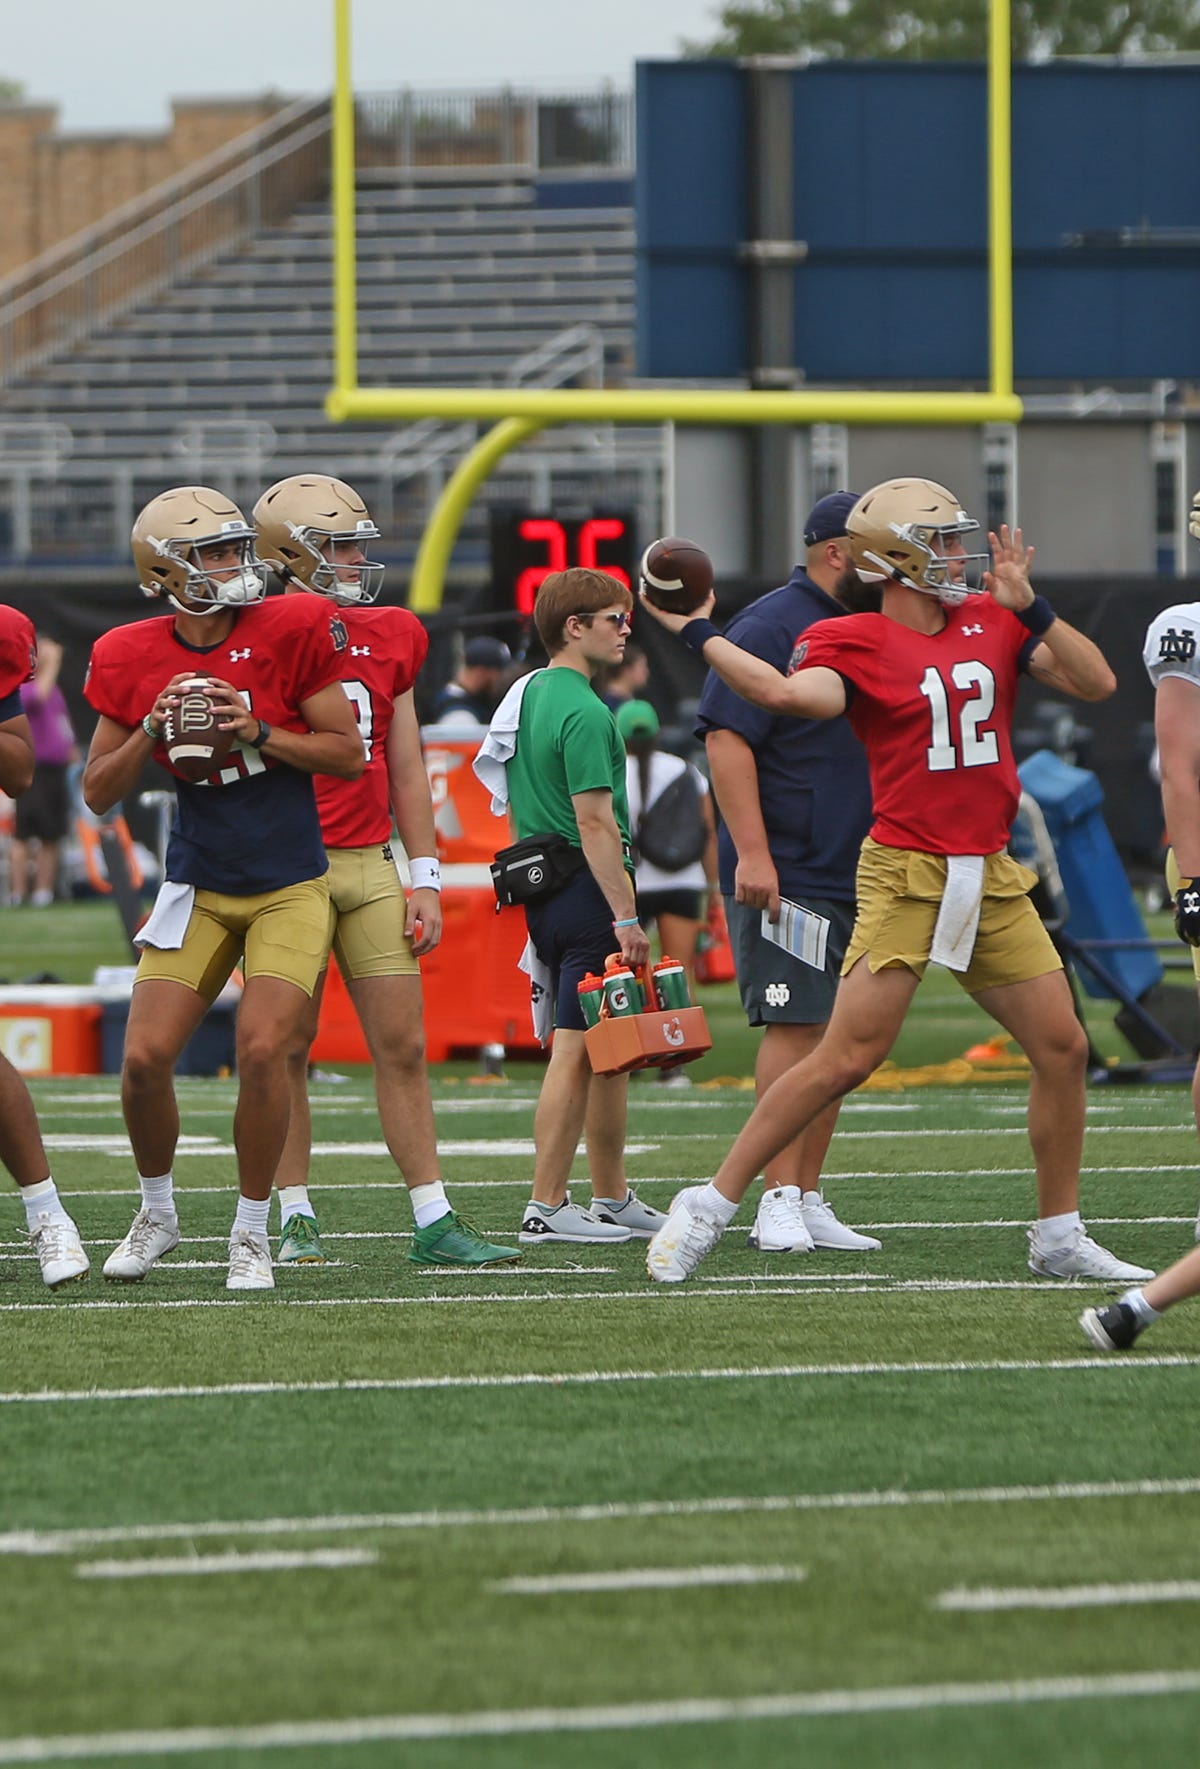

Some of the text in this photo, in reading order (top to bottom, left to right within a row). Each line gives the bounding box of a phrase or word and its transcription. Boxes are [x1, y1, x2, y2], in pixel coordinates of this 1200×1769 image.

[920, 660, 1000, 771] 12
[610, 988, 629, 1010] G
[765, 983, 790, 1007] ND
